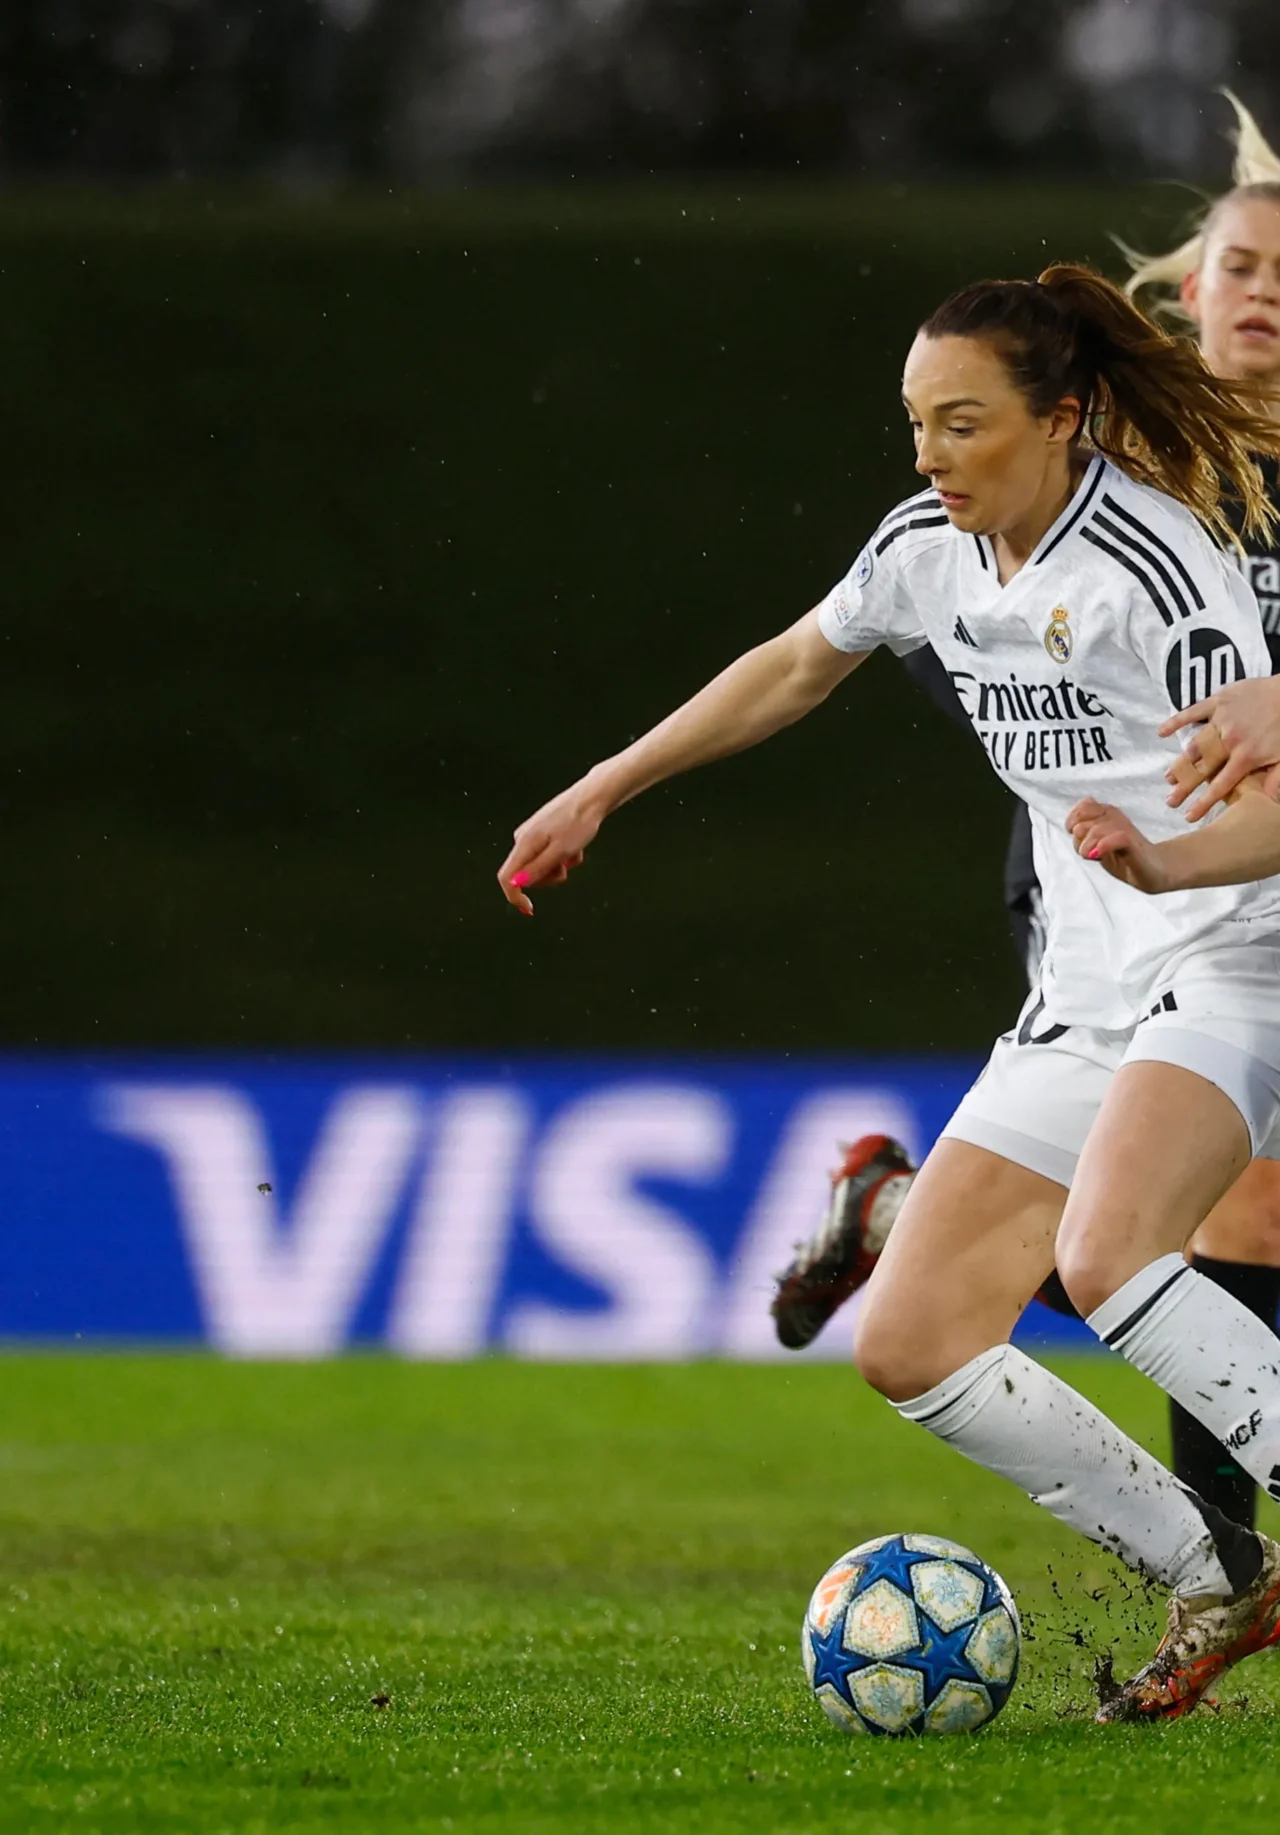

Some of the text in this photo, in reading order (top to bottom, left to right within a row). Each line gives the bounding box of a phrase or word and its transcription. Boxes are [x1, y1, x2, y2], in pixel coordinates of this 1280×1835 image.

[1181, 630, 1235, 709] hp
[948, 672, 1114, 721] Emirate
[1024, 727, 1113, 770] BETTER
[1221, 1409, 1262, 1452] MCF
